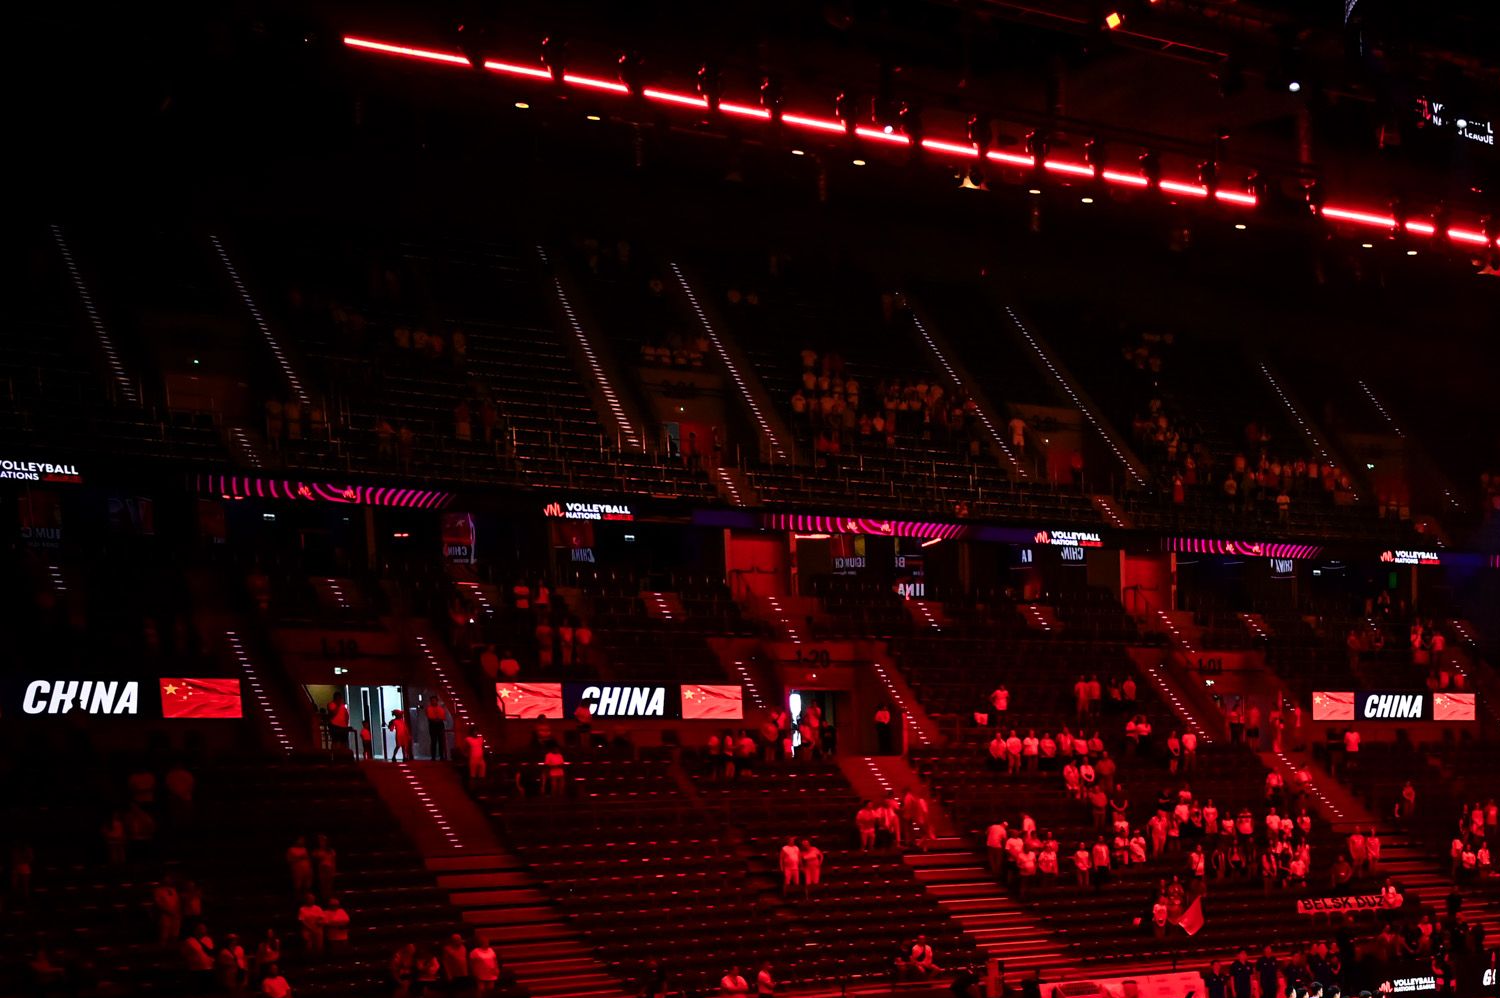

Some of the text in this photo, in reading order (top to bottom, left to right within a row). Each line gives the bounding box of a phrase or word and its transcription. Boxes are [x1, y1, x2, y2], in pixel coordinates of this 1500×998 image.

[0, 460, 79, 475] OLLEYBALL
[0, 471, 39, 480] ATIONS
[566, 503, 631, 514] VOLLEYBALL
[566, 512, 601, 520] NATIONS
[1051, 531, 1101, 542] VOLLEYBALL
[1395, 550, 1439, 560] VOLLEYBALL
[22, 679, 139, 715] CHINA
[1364, 694, 1424, 719] CHINA
[1303, 896, 1353, 911] BELSK
[1393, 976, 1436, 987] VOLLEYBALL
